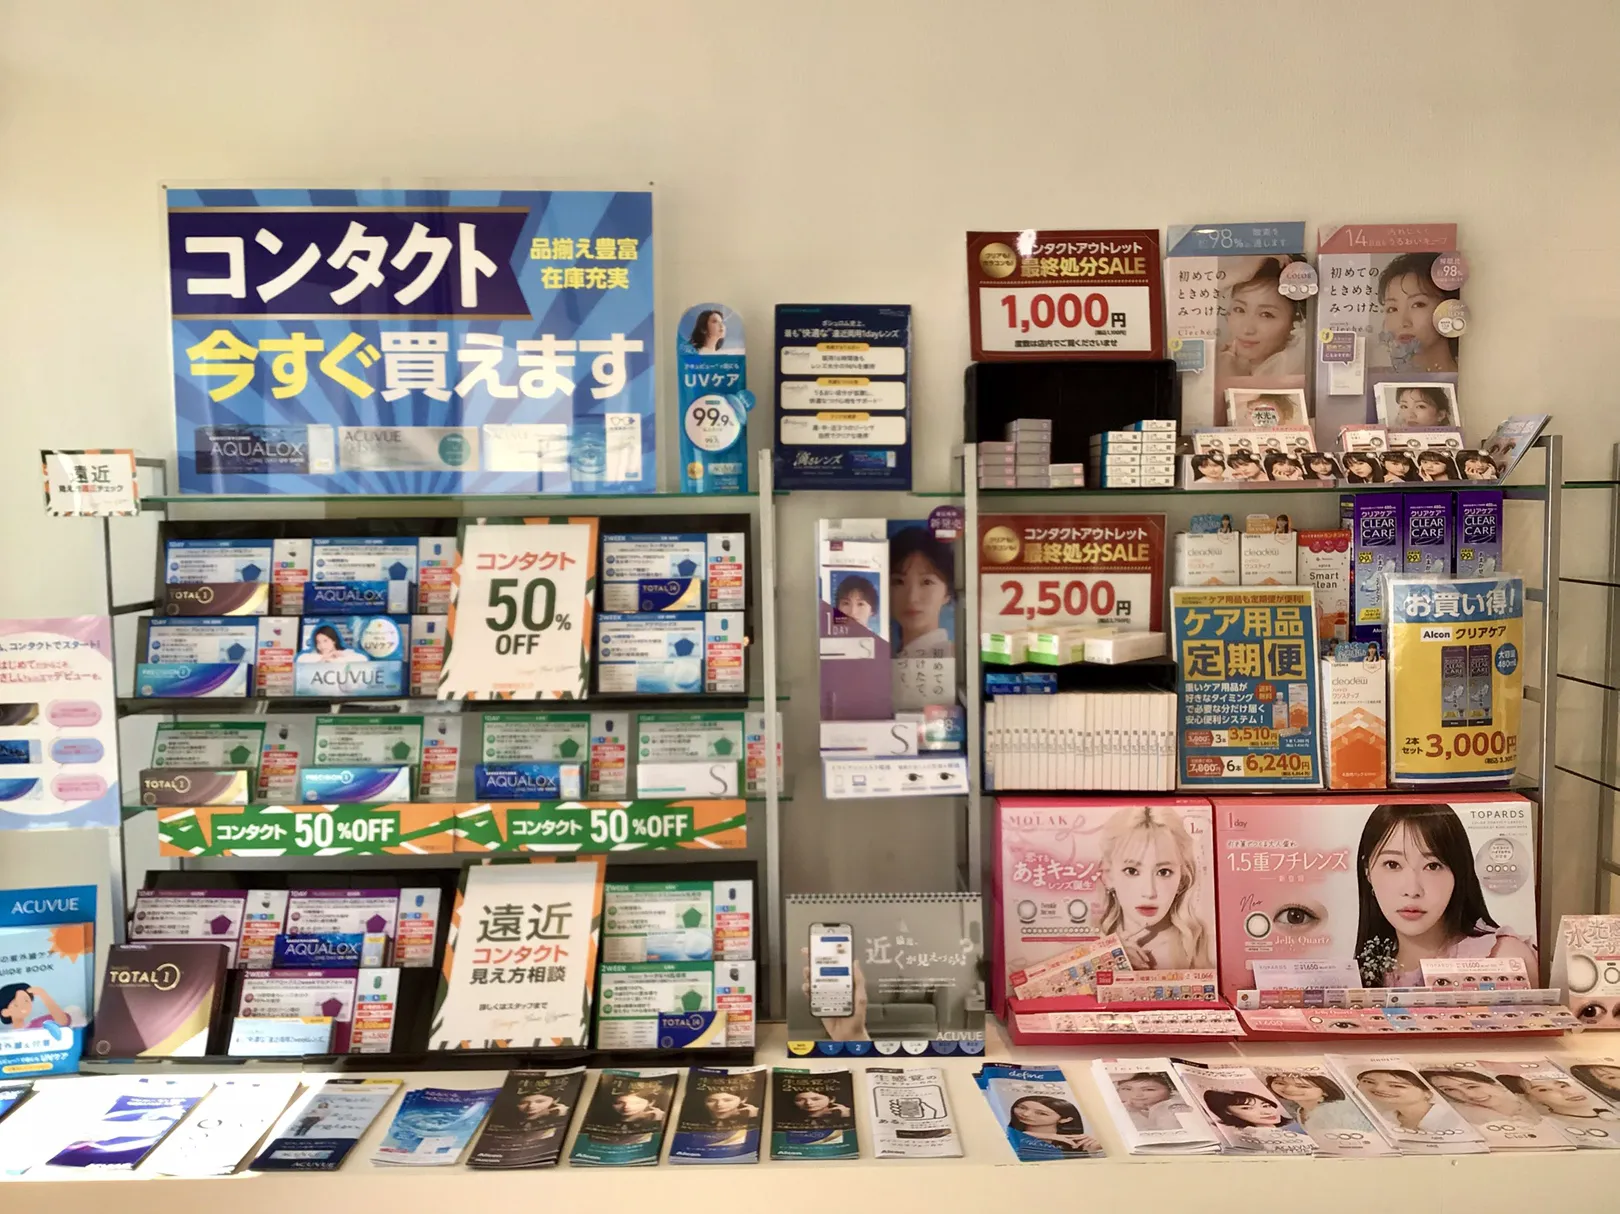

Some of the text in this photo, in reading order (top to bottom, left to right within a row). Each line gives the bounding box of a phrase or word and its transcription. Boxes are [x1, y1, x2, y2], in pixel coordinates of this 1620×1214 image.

[530, 238, 638, 260] 品揃え豊富
[1026, 241, 1143, 255] ンタクトアウトレット
[184, 221, 498, 308] コンタクト
[1020, 256, 1147, 278] 最終処分SALE
[541, 267, 629, 290] 在庫充実
[1178, 270, 1227, 282] 初めての
[1330, 266, 1379, 279] 初めての
[1178, 288, 1226, 300] ときめき、
[1330, 284, 1379, 296] ときめき、
[1178, 305, 1232, 317] みつけた。
[1330, 302, 1384, 314] みつけた。
[186, 329, 644, 402] 今すぐ買えます
[684, 373, 740, 388] UVケア
[344, 431, 402, 443] ACUVUE
[210, 442, 304, 458] AQUALOX
[1410, 509, 1443, 517] クリアケア
[1463, 508, 1495, 516] クリアケア
[1361, 517, 1396, 528] CLEAR
[1411, 517, 1445, 528] CLEAR
[1464, 516, 1496, 526] CLEAR
[1024, 528, 1148, 541] コンタクトアウトレット
[1361, 528, 1396, 538] CARE
[1411, 528, 1445, 538] CARE
[1464, 526, 1496, 536] CARE
[1023, 543, 1150, 564] 最終処分SALE
[476, 551, 577, 572] コンタクト
[1309, 571, 1340, 581] Smart
[642, 584, 668, 592] TOTAL
[314, 589, 386, 601] AQUALOX
[485, 577, 573, 632] 50%
[1404, 588, 1516, 618] お買い得!
[1183, 607, 1304, 637] ケア用品
[832, 626, 850, 635] DAY
[1423, 625, 1507, 640] Alcon クリアケア
[495, 634, 541, 656] OFF
[1186, 642, 1303, 678] 定期便
[310, 670, 385, 686] ACUVUE
[1332, 677, 1369, 686] cleadew
[1185, 693, 1255, 703] 好きなタイミング
[1185, 703, 1266, 714] で必要な分だけ届く
[890, 724, 910, 756] S
[1229, 725, 1278, 742] 3,510円
[1405, 737, 1420, 745] 2本
[1402, 746, 1424, 755] セット
[1226, 753, 1311, 774] 6本 6,240円
[144, 780, 176, 789] TOTAL
[486, 775, 556, 788] AQUALOX
[709, 764, 728, 796] S
[1470, 810, 1525, 819] TOPARDS
[215, 824, 288, 842] コンタクト
[511, 820, 583, 837] コンタクト
[1227, 850, 1349, 872] 1.5重フチレンズ
[1013, 859, 1095, 887] あまキュン
[10, 897, 80, 915] ACUVUE
[476, 901, 573, 944] 遠近
[1274, 935, 1330, 947] Jelly Quartz
[285, 943, 360, 956] AQUALOX
[471, 944, 570, 966] コンタクト
[25, 965, 55, 975] BOOK
[469, 965, 567, 986] 見え方相談
[601, 965, 627, 973] 2WEEK
[109, 971, 159, 984] TOTAL
[478, 1001, 549, 1012] 詳しくはスタッフまで
[661, 1018, 690, 1027] TOTAL
[935, 1031, 984, 1042] ACUVUE
[855, 1044, 862, 1052] 2
[1008, 1070, 1044, 1080] define
